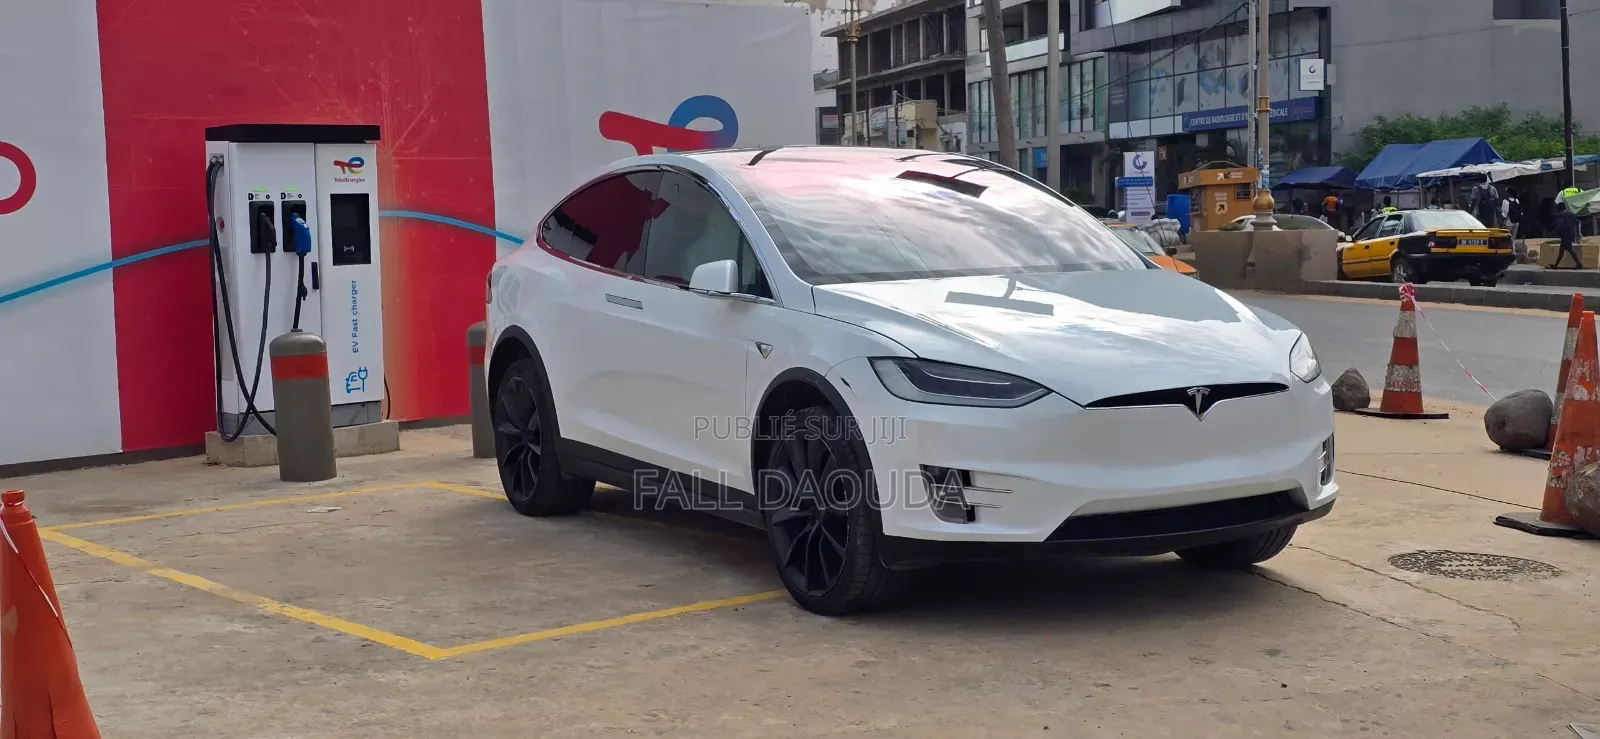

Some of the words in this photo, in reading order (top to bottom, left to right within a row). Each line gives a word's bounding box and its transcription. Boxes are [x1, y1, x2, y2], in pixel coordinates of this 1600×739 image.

[1190, 116, 1206, 126] CENTRE
[350, 279, 359, 316] charger
[351, 318, 359, 338] Fast
[352, 341, 359, 353] EV
